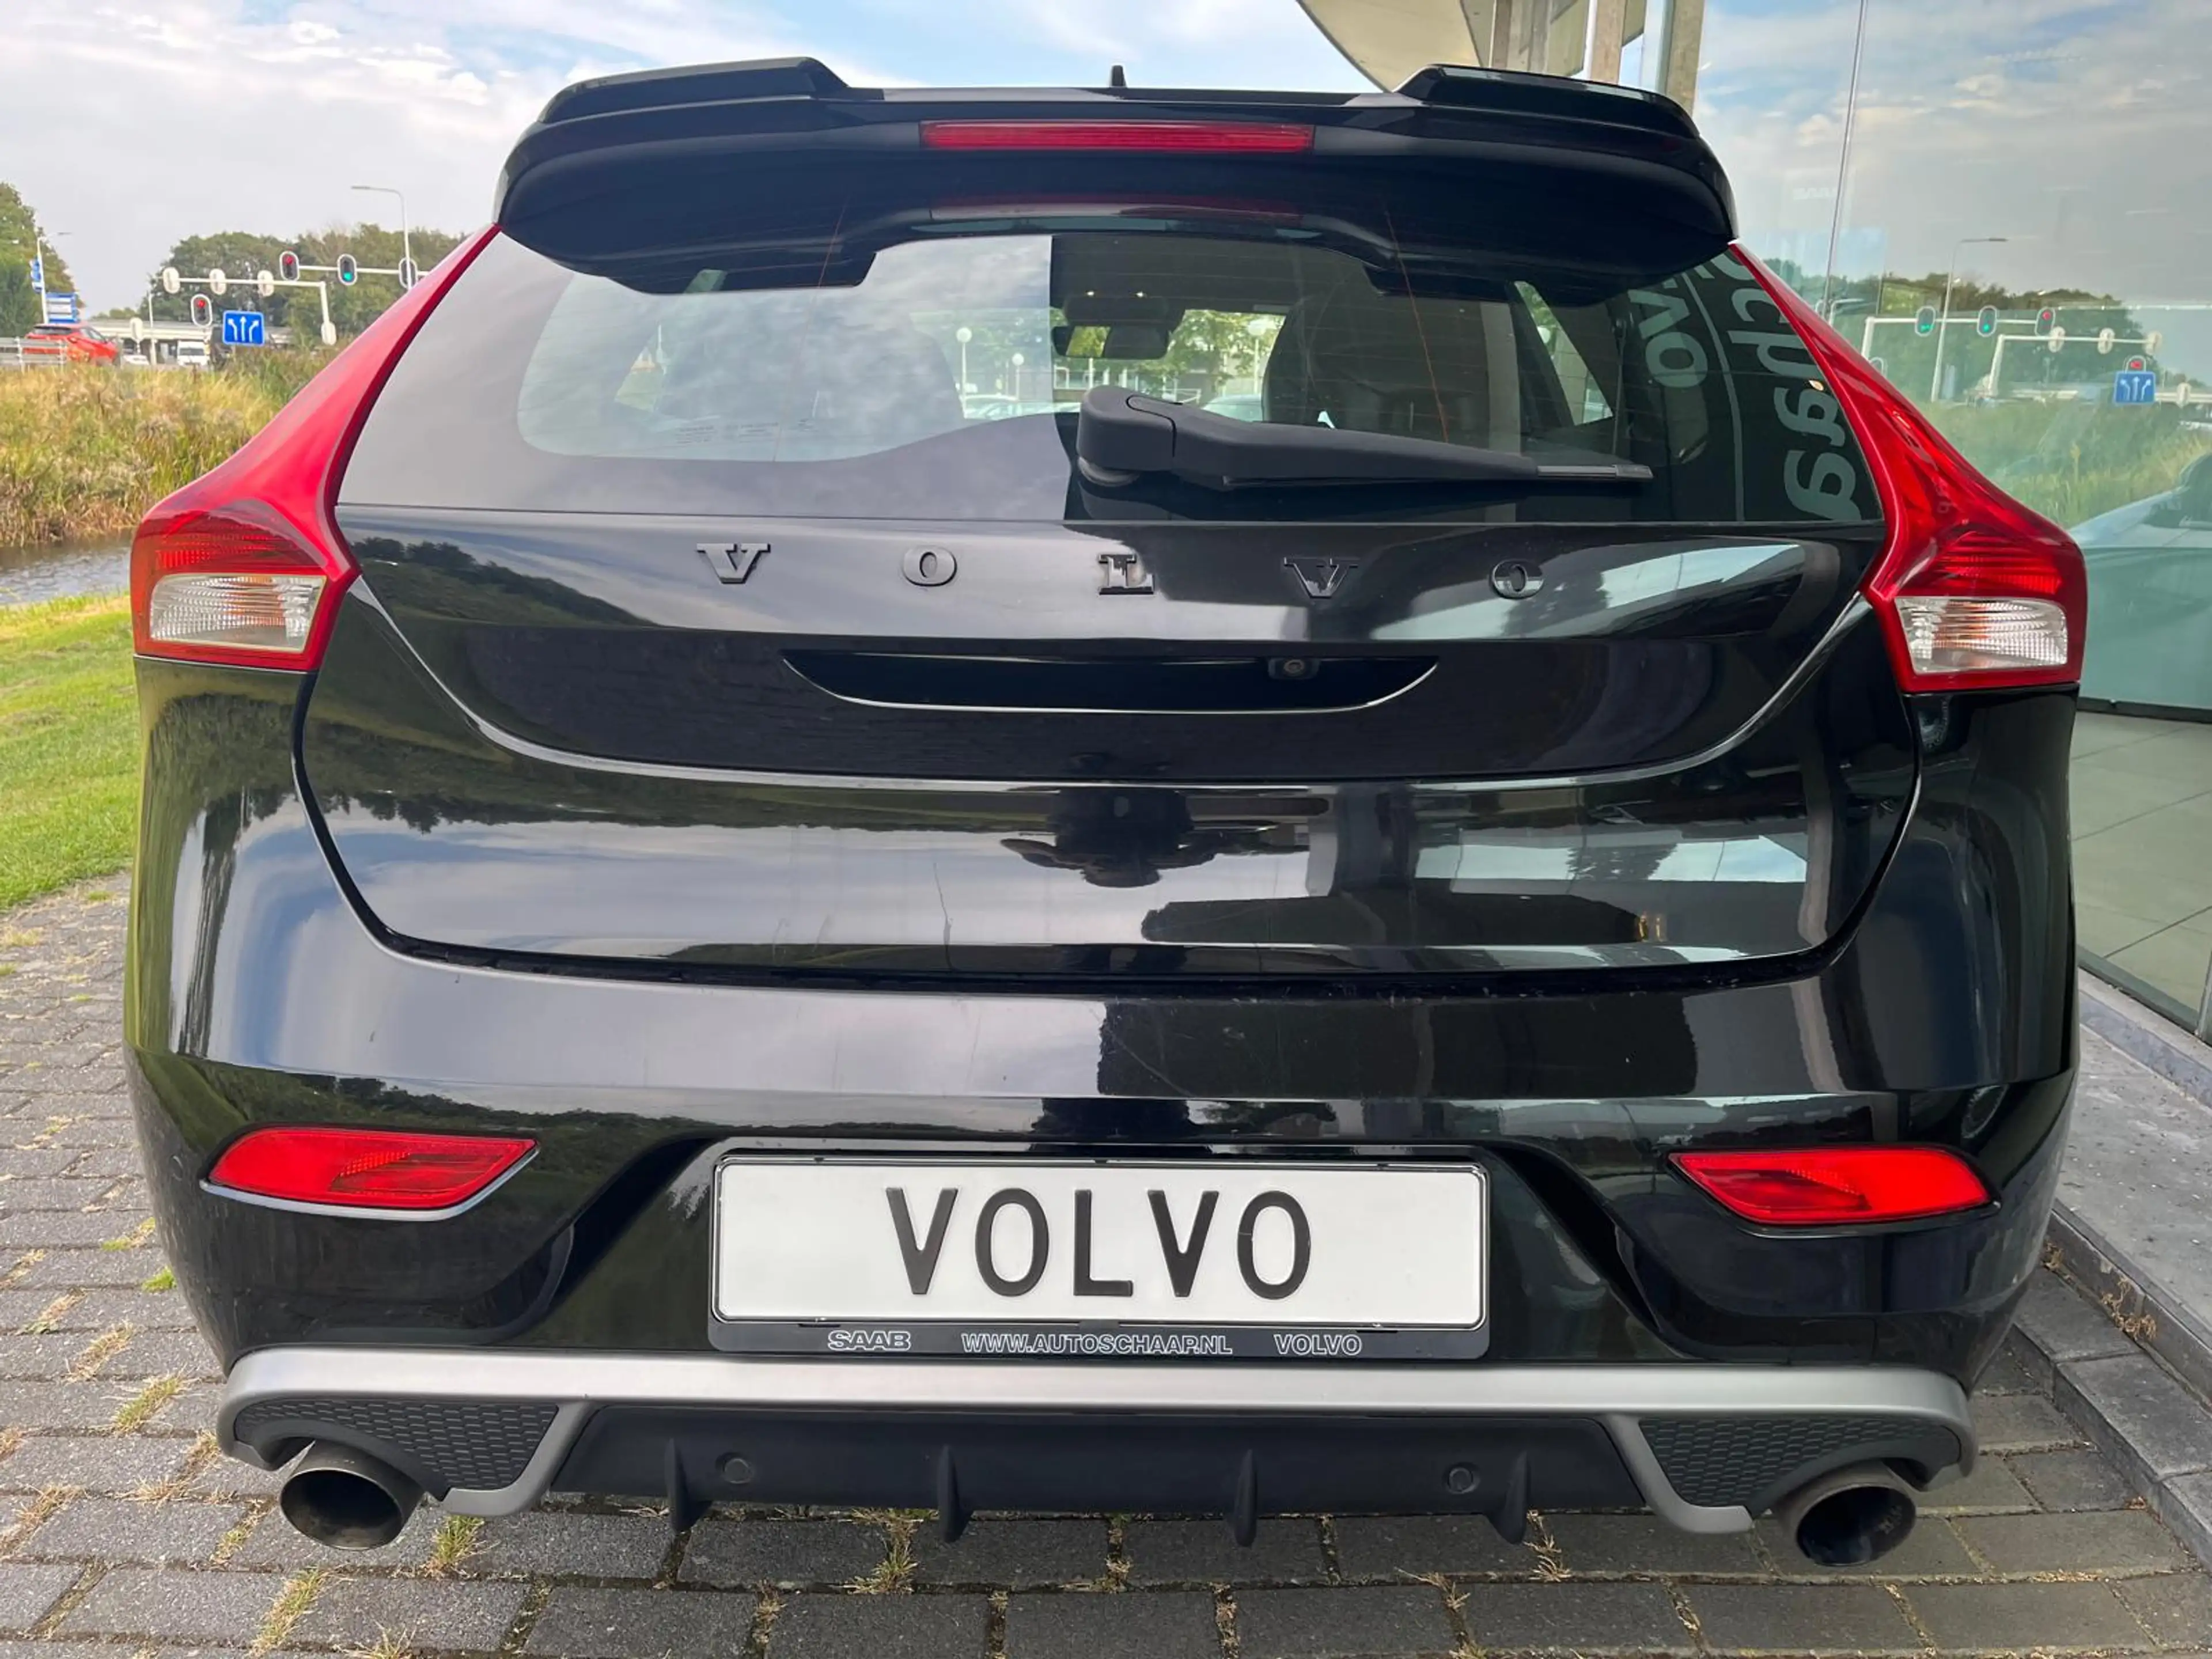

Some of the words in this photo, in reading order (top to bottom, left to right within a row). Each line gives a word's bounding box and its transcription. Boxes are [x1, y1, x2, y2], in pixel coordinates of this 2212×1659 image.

[696, 543, 1546, 600] VOLVO
[885, 1187, 1312, 1300] VOLVO
[828, 1330, 911, 1351] SAAB
[961, 1333, 1233, 1355] WWW.AUTOSCHAAP.NL
[1274, 1334, 1362, 1355] VOLVO
